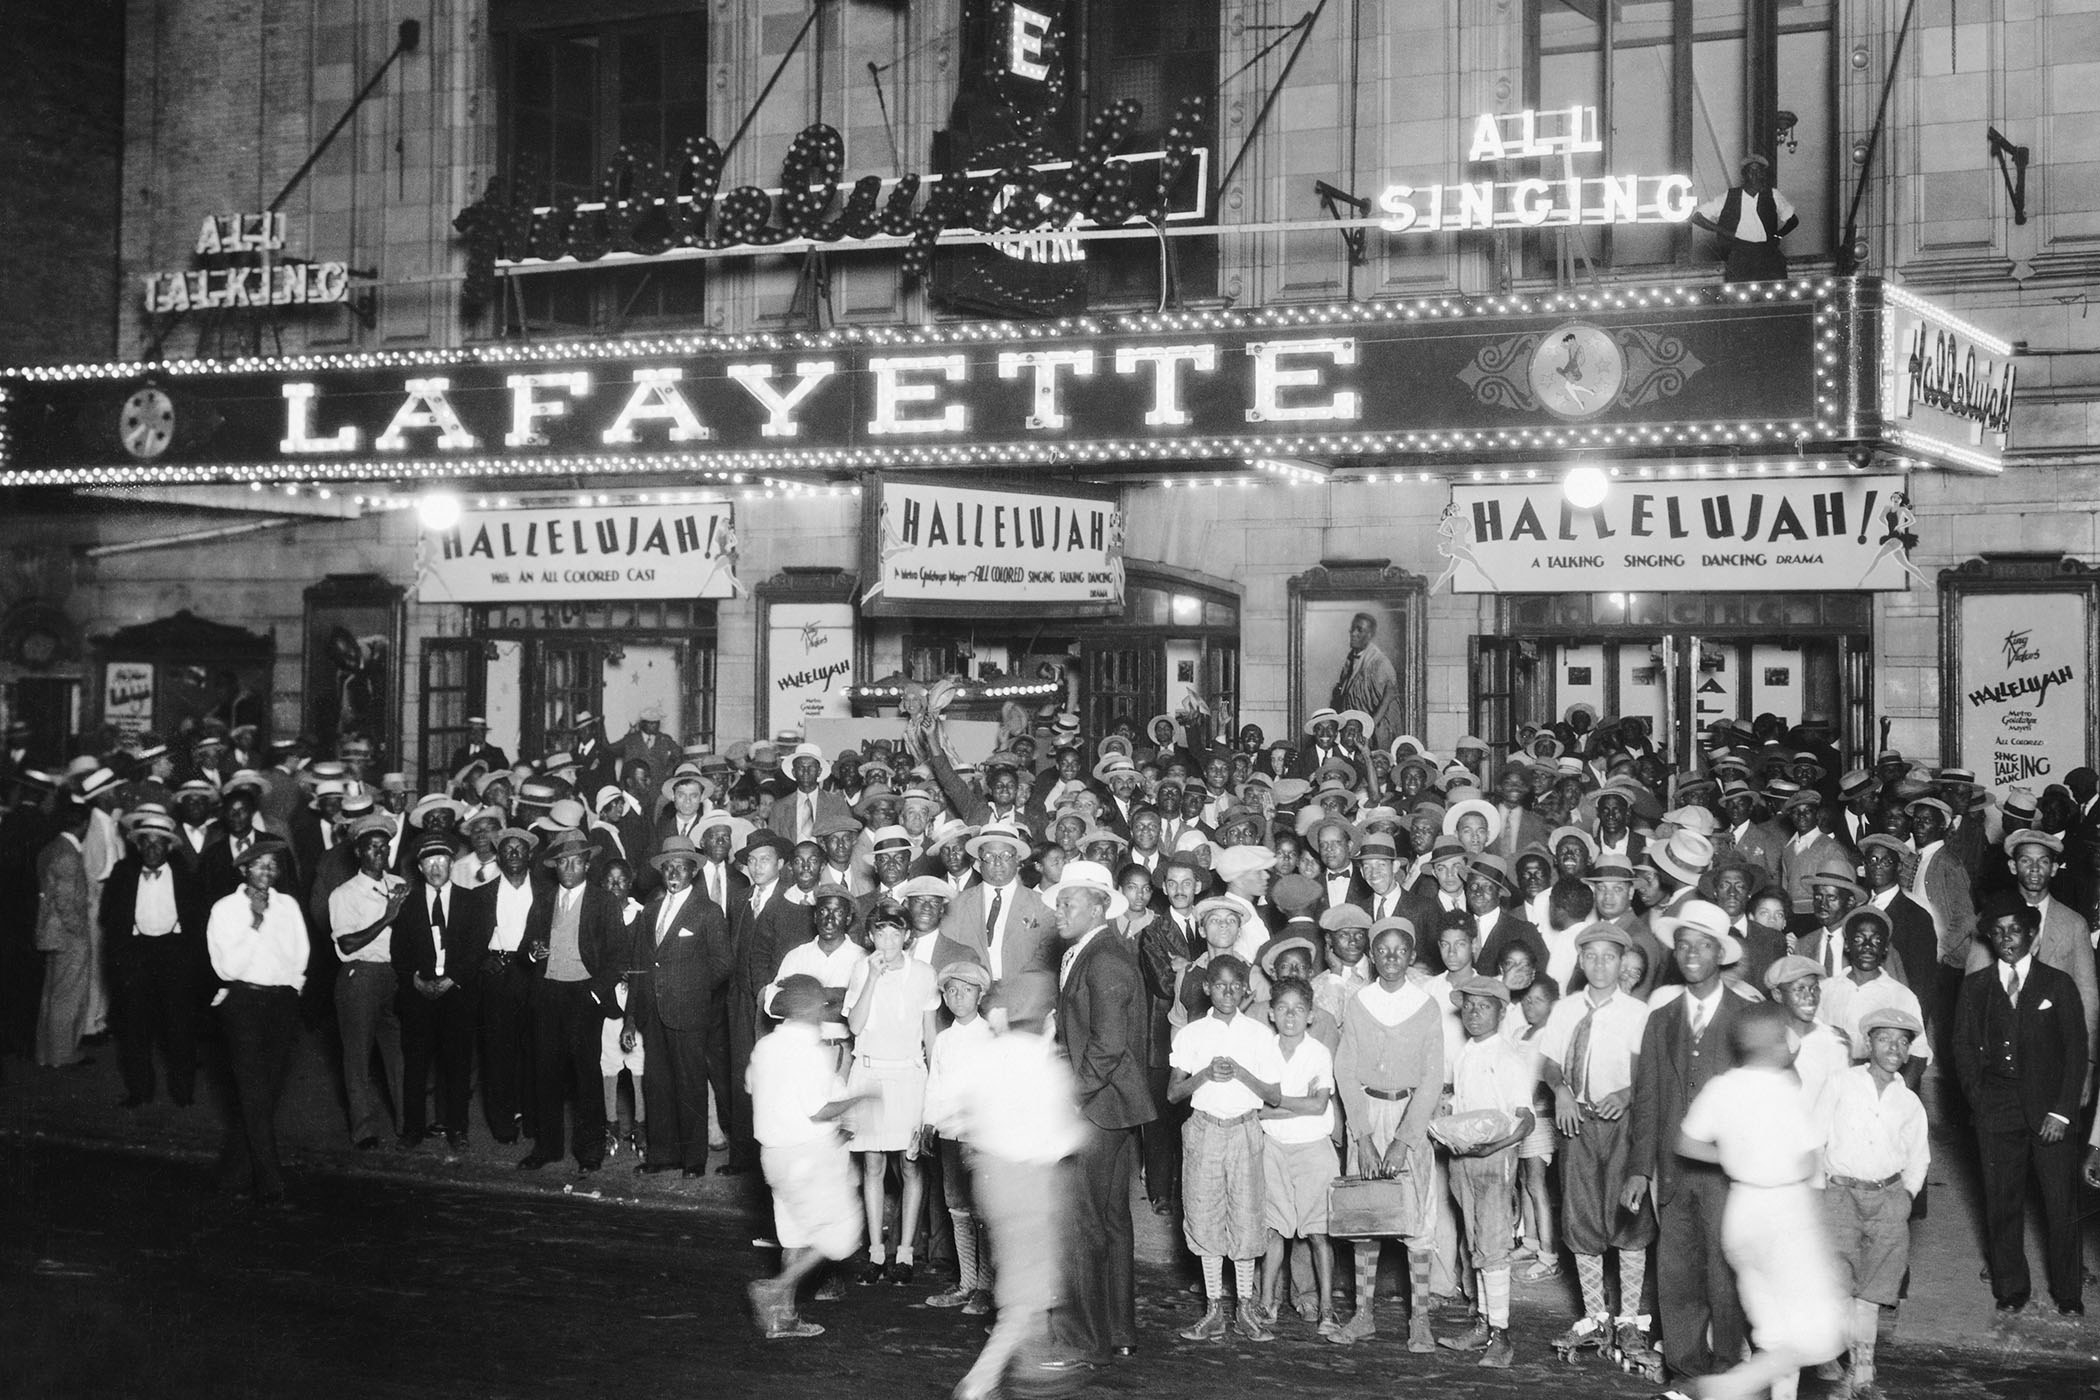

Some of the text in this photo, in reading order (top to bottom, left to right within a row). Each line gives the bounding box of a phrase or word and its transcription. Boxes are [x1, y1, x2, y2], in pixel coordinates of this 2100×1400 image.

[1468, 105, 1602, 162] ALL
[1378, 173, 1698, 233] SINGING
[196, 211, 284, 253] ALL
[143, 261, 348, 313] TALKING
[280, 338, 1355, 453] LAFAYETTE
[442, 515, 718, 560] HALLELUJAH!
[1471, 490, 1879, 545] HALLELUJAH!
[991, 564, 1024, 584] COLORED
[1531, 552, 1824, 569] A TALKING SINGING DANCING DRAMA
[777, 659, 850, 693] HALLELUJAH
[1968, 665, 2074, 708] HALLELUJAH
[1993, 761, 2020, 777] TALK
